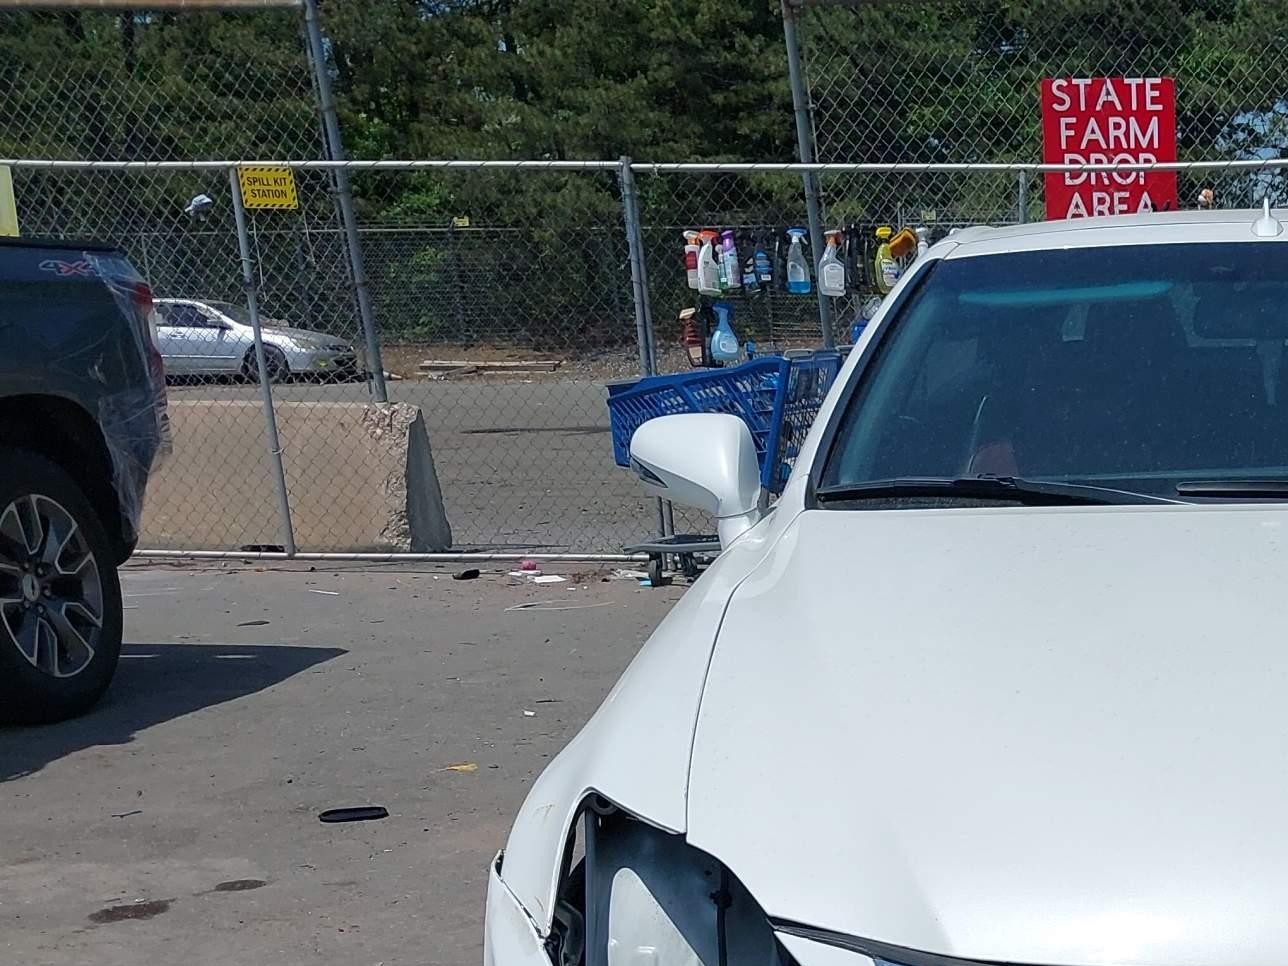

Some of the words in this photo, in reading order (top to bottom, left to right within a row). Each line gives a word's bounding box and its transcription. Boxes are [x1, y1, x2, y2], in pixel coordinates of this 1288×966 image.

[1051, 78, 1164, 112] STATE
[1060, 116, 1159, 150] FARM
[246, 176, 272, 187] SPILL
[273, 176, 288, 187] KIT
[1064, 152, 1157, 186] DROP
[250, 188, 288, 199] STATION
[1065, 191, 1154, 220] AREA
